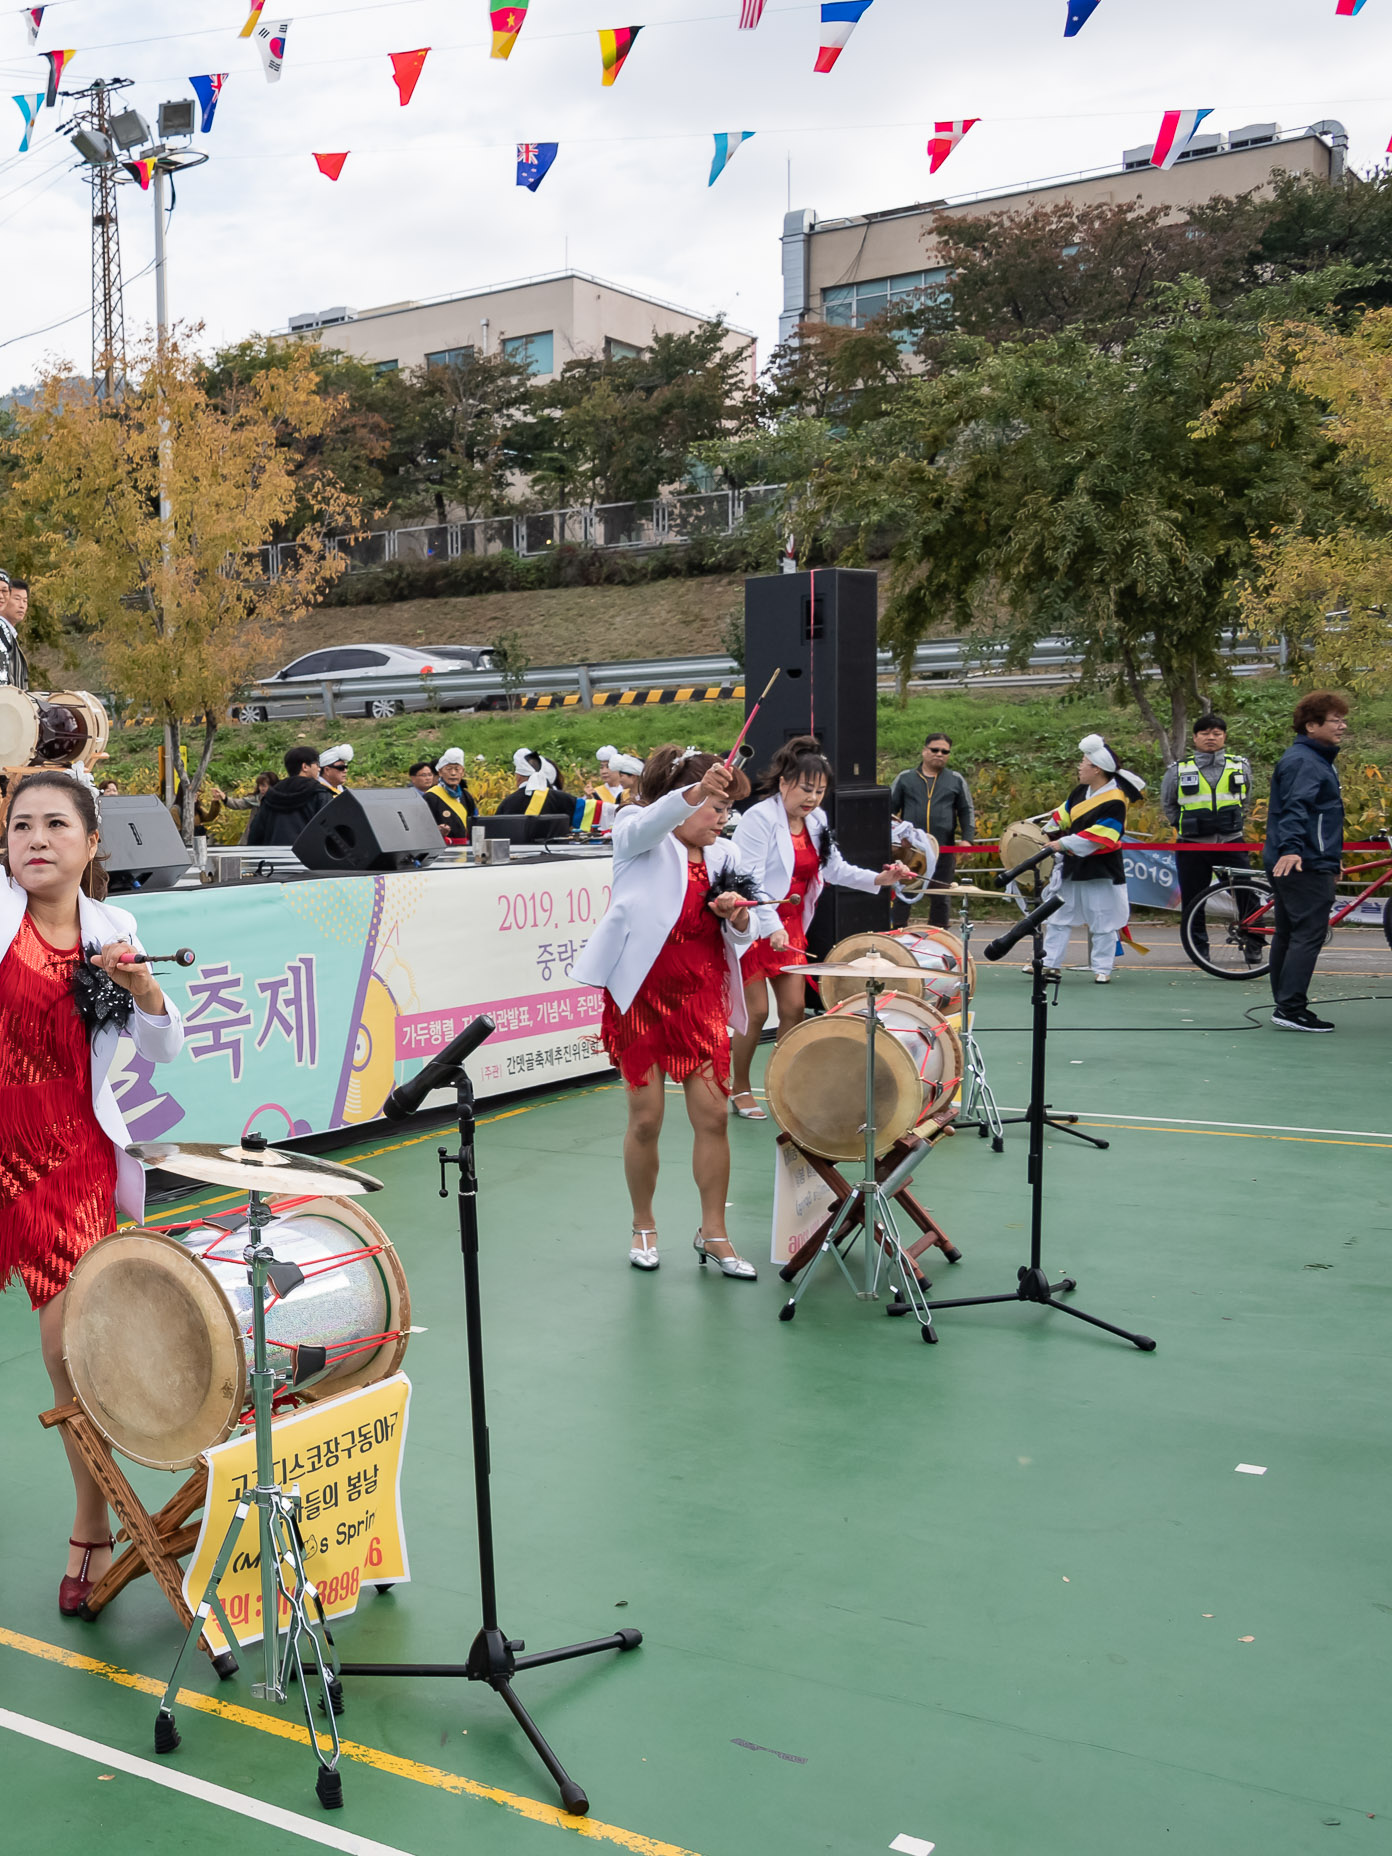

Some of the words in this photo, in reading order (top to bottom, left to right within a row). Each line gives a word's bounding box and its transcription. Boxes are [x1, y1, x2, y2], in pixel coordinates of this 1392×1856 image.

[1123, 858, 1173, 887] 2019
[536, 938, 589, 981] 중랑
[346, 1463, 380, 1502] 봄날
